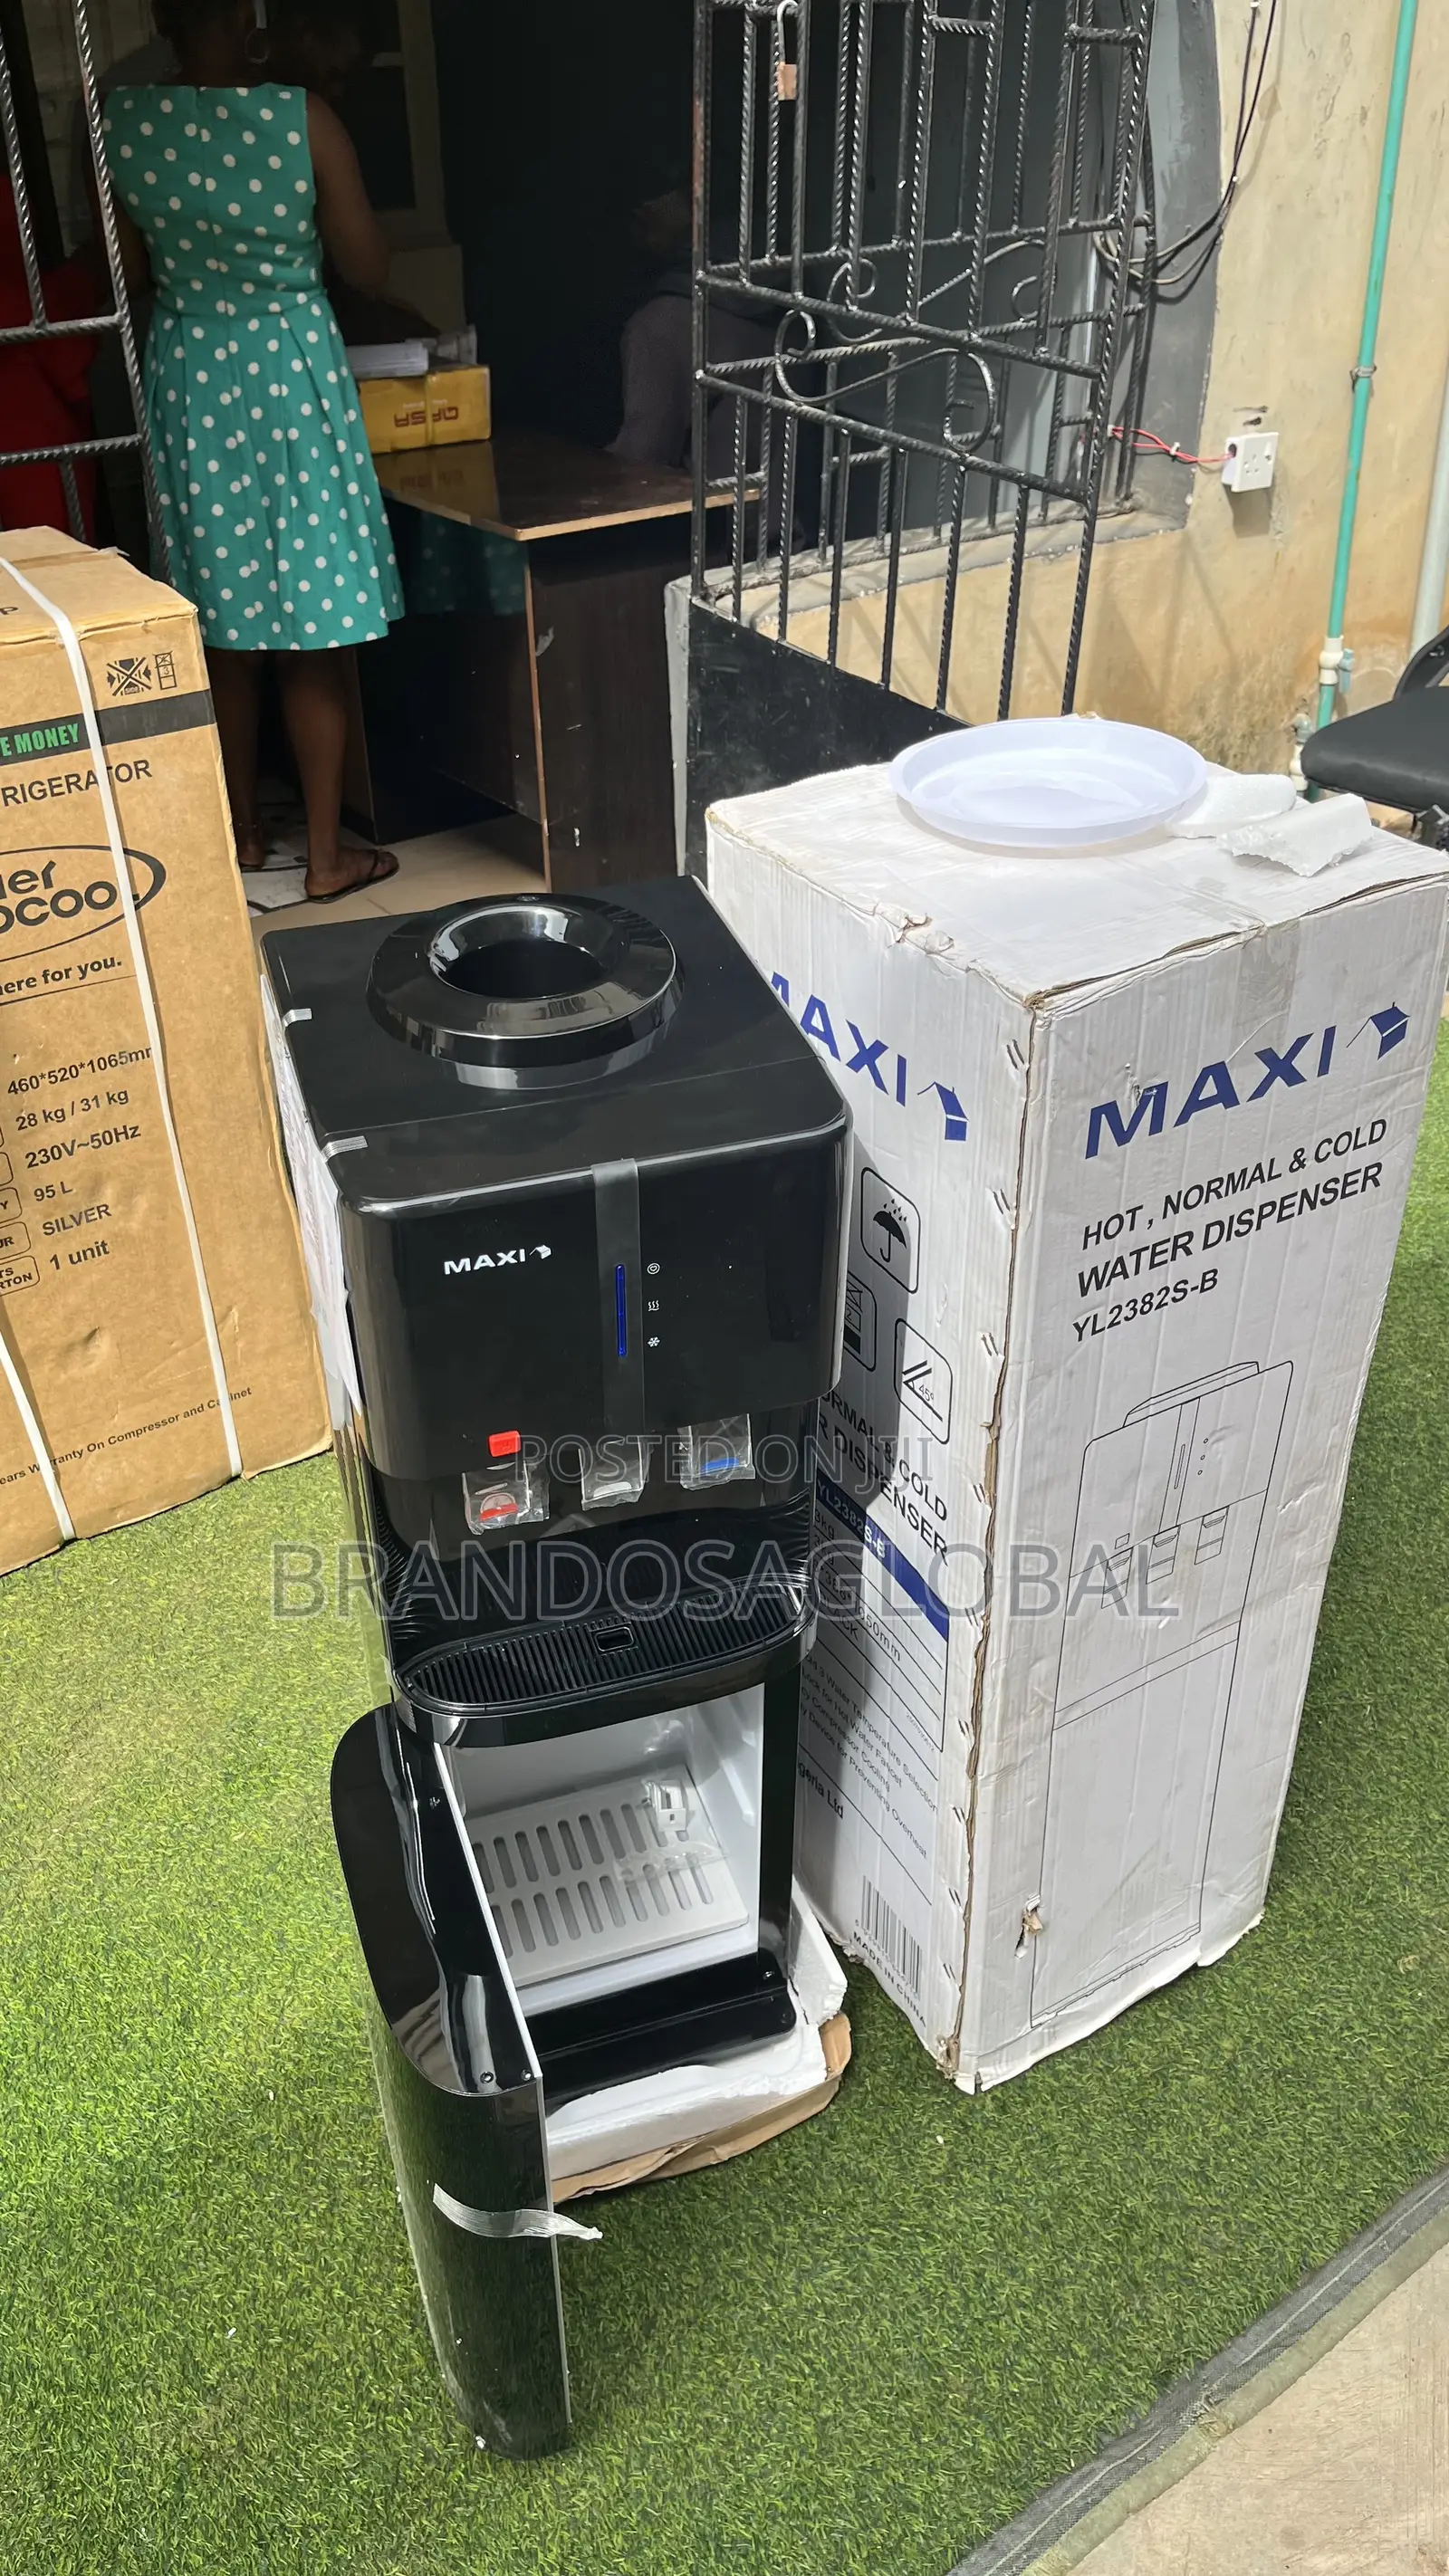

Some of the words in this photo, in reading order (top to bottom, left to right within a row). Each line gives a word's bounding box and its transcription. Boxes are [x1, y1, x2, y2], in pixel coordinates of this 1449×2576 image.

[14, 723, 80, 754] MONEY
[42, 967, 72, 985] for
[76, 956, 122, 981] you.
[15, 1113, 38, 1132] 28
[43, 1106, 66, 1123] kg
[80, 1094, 101, 1113] 31
[106, 1089, 130, 1106] kg
[1085, 1025, 1337, 1160] MAXI
[24, 1124, 142, 1169] 230V~50Hz
[1162, 1157, 1282, 1220] NORMAL
[1289, 1147, 1307, 1173] &
[1314, 1117, 1387, 1163] COLD
[34, 1184, 56, 1202] 95
[61, 1181, 73, 1195] L
[42, 1203, 112, 1237] SILVER
[49, 1254, 61, 1270] 1
[68, 1239, 110, 1266] unit
[443, 1249, 526, 1276] MAXI
[1078, 1230, 1194, 1298] WATER
[1202, 1162, 1384, 1251] DISPENSER
[1072, 1268, 1219, 1343] YL2382S-B
[28, 1449, 84, 1474] Wrranty
[87, 1441, 105, 1452] On
[108, 1413, 180, 1447] Compressor
[183, 1403, 205, 1419] and
[206, 1386, 253, 1410] Cainet
[817, 1480, 886, 1558] YL2382S-B
[835, 1426, 948, 1566] DISPENSER
[899, 1459, 947, 1521] COLD
[812, 1697, 859, 1754] Compressor
[861, 1750, 890, 1793] Cooling
[822, 1688, 832, 1705] for
[849, 1718, 874, 1752] Water
[826, 1672, 849, 1705] Water
[852, 1700, 902, 1767] Temperature
[903, 1763, 938, 1815] Selection
[827, 1788, 844, 1819] Ltd
[838, 1742, 848, 1759] for
[849, 1757, 890, 1812] Preventing
[892, 1808, 927, 1859] Overheat
[854, 1930, 882, 1970] MADE
[885, 1967, 894, 1985] IN
[897, 1983, 926, 2028] CHINA
